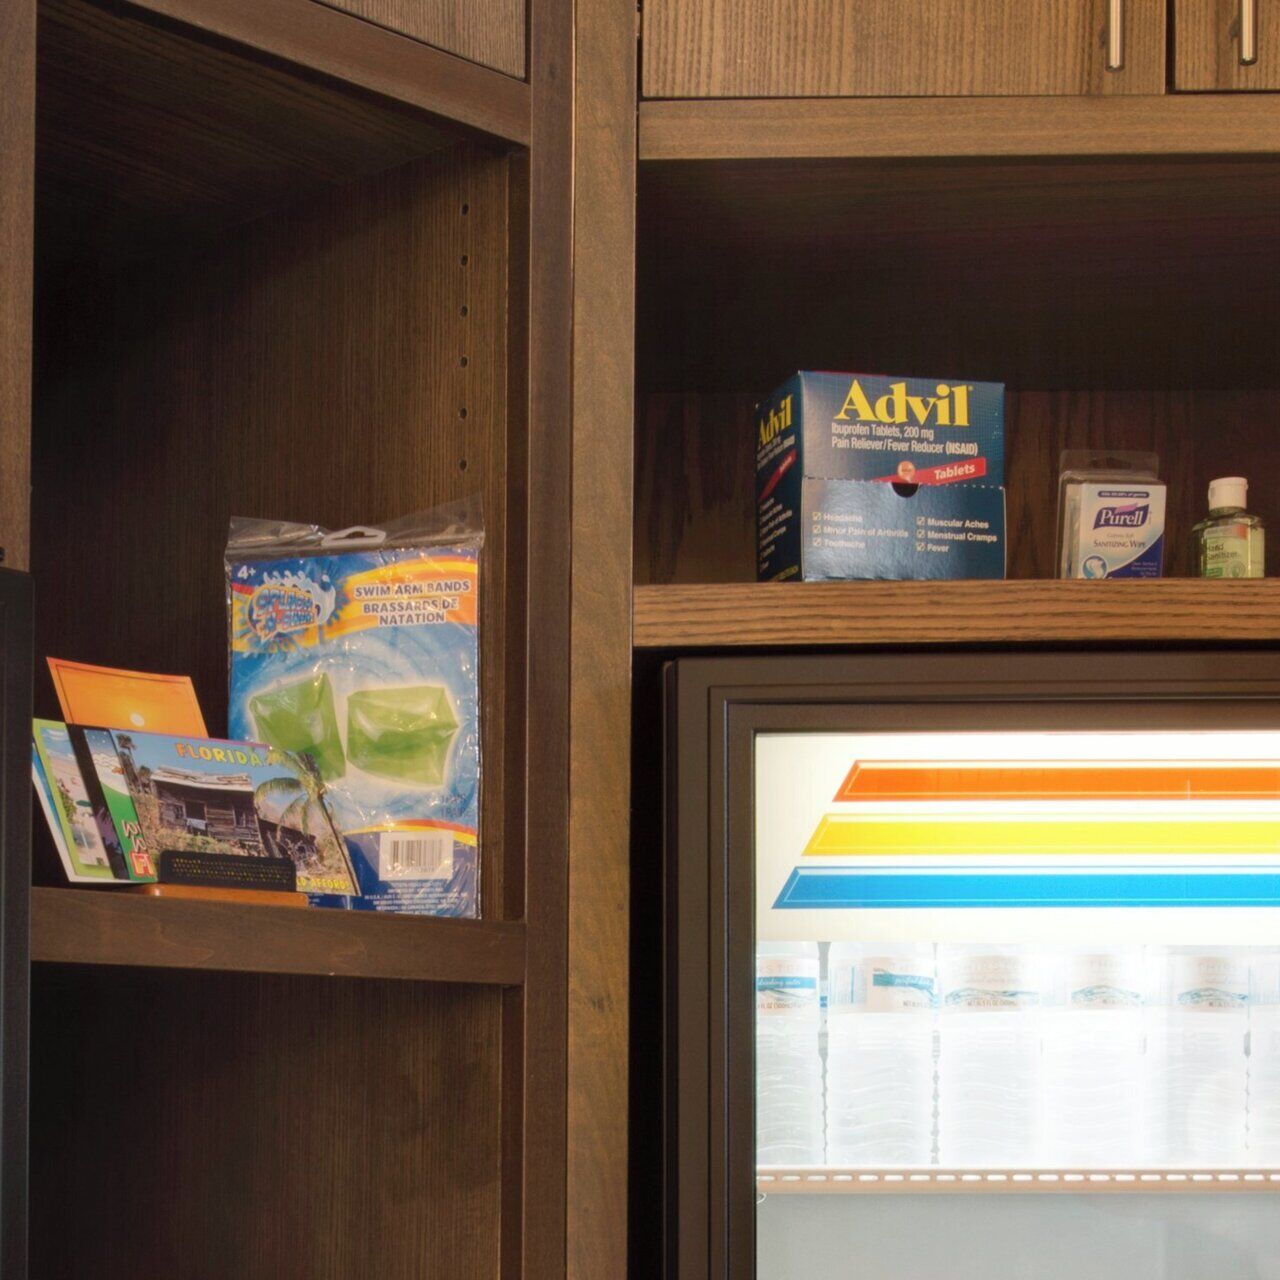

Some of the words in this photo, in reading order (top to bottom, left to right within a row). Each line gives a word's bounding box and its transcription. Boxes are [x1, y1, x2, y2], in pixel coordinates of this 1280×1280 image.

[833, 378, 970, 427] Advil
[831, 422, 870, 437] Ibuprofen
[871, 424, 902, 438] Tablets,
[904, 426, 920, 437] 200
[831, 436, 849, 449] Pain
[911, 441, 944, 454] Reducer
[945, 441, 978, 456] (NSAID)
[934, 463, 976, 480] Tablets
[927, 518, 963, 529] Muscular
[964, 519, 989, 530] Aches
[1100, 509, 1145, 527] Purell
[927, 530, 966, 541] Menstrual
[967, 532, 997, 544] Cramps
[927, 543, 950, 553] Fever
[237, 565, 257, 580] 4+
[355, 585, 391, 598] SWIM
[395, 584, 423, 596] ARM
[427, 580, 470, 595] BANDS
[363, 600, 438, 614] BRASSARDS
[378, 613, 446, 627] NATATION
[176, 742, 261, 768] FLORIDA
